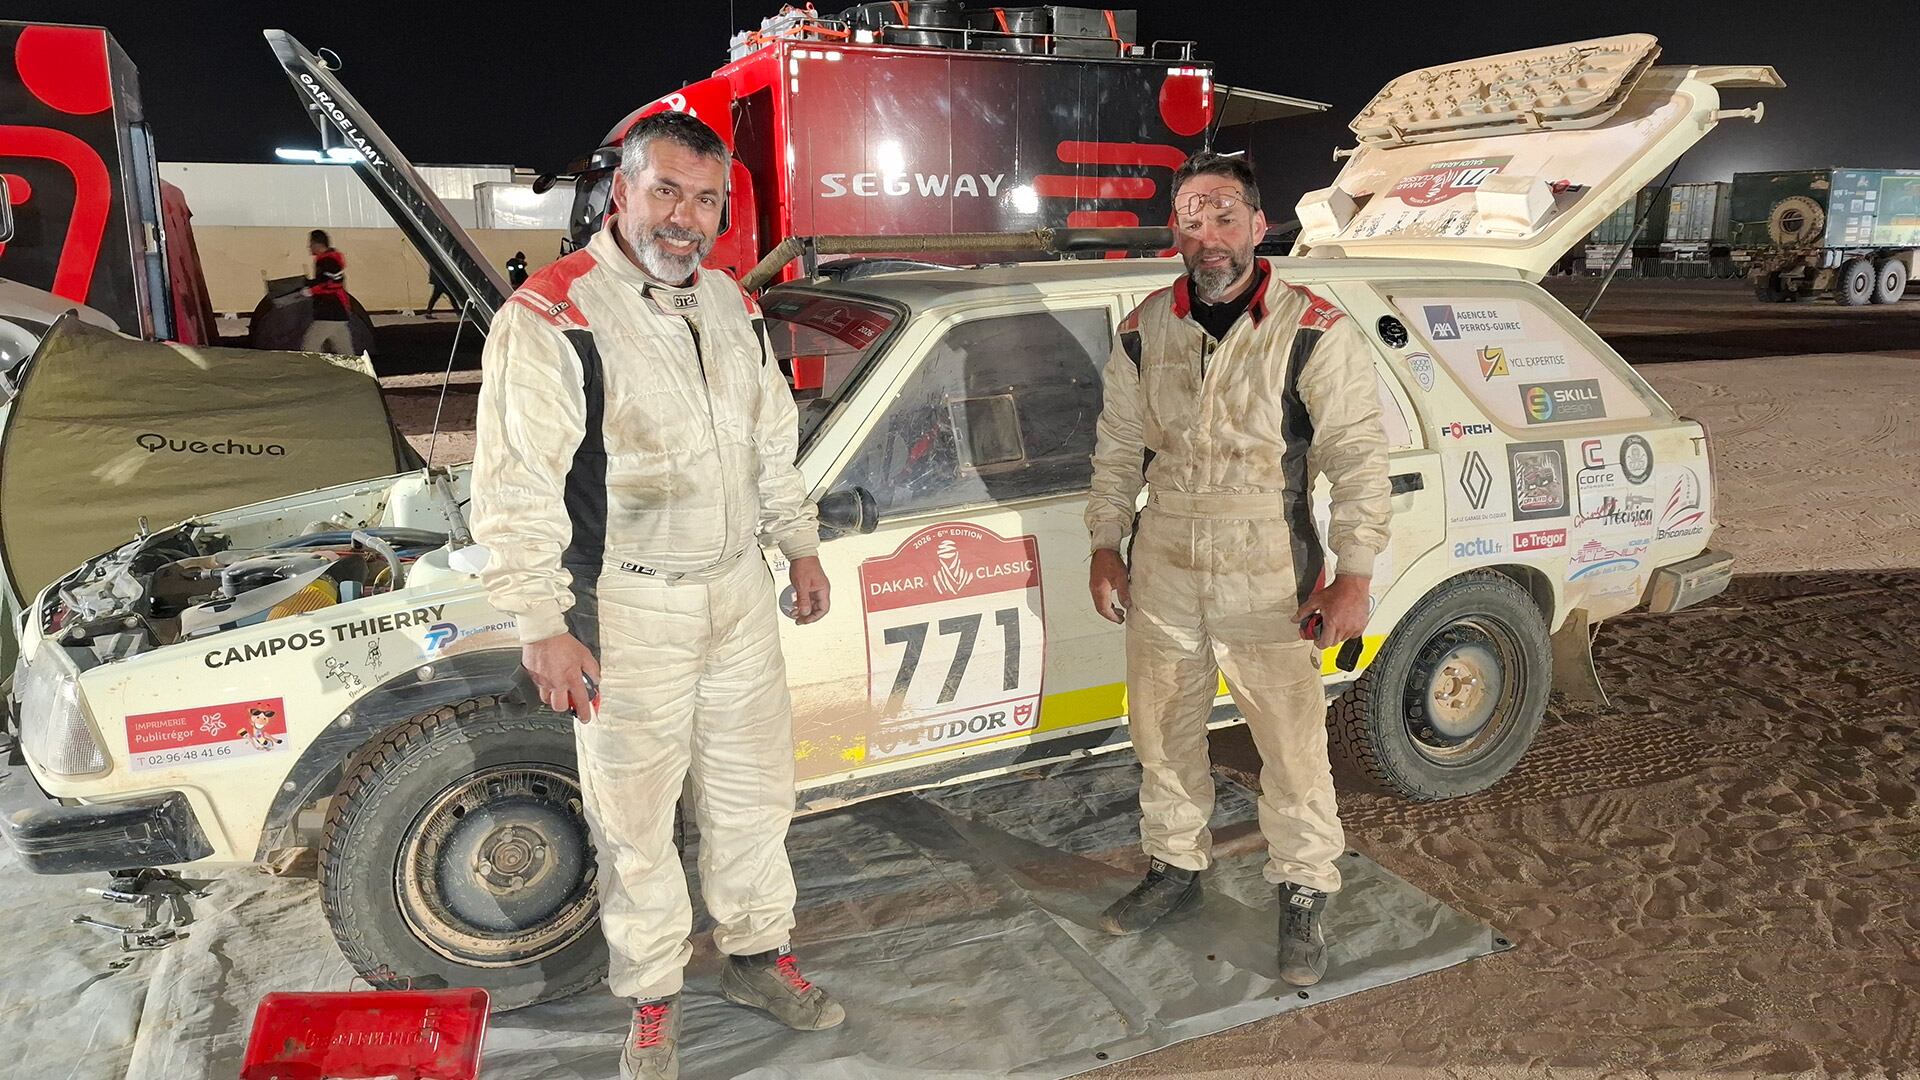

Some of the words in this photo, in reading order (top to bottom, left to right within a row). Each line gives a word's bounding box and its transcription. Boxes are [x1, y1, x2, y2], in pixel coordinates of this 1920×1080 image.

[300, 74, 353, 130] GARAGE
[347, 128, 384, 166] LAMY
[820, 172, 1005, 198] SEGWAY
[1396, 181, 1426, 190] DAKAR
[1456, 310, 1486, 320] AGENCE
[1487, 310, 1498, 319] DE
[1432, 323, 1456, 337] AXA
[1460, 322, 1521, 332] PERROS-GUIREC
[1509, 357, 1524, 368] YCL
[1526, 355, 1565, 367] EXPERTISE
[1554, 387, 1598, 402] SKILL
[1557, 402, 1593, 416] design
[136, 433, 286, 456] Quechua
[1580, 473, 1614, 485] corre
[912, 534, 932, 550] 2026
[950, 528, 983, 541] EDITION
[1454, 537, 1502, 558] actu.fr
[1515, 535, 1532, 548] Le
[1533, 531, 1565, 548] Trégor
[870, 576, 925, 596] DAKAR
[975, 559, 1034, 580] CLASSIC
[204, 628, 326, 669] CAMPOS
[331, 605, 447, 642] THIERRY
[460, 620, 516, 637] TechniPROFIL
[883, 606, 1021, 719] 771
[135, 717, 188, 731] IMPRIMERIE
[906, 710, 1007, 747] TUDOR
[135, 729, 195, 744] Publitrégor
[137, 757, 146, 766] T
[148, 756, 164, 766] 02
[167, 753, 181, 763] 96
[183, 750, 198, 760] 48
[200, 748, 214, 758] 41
[216, 745, 232, 756] 66
